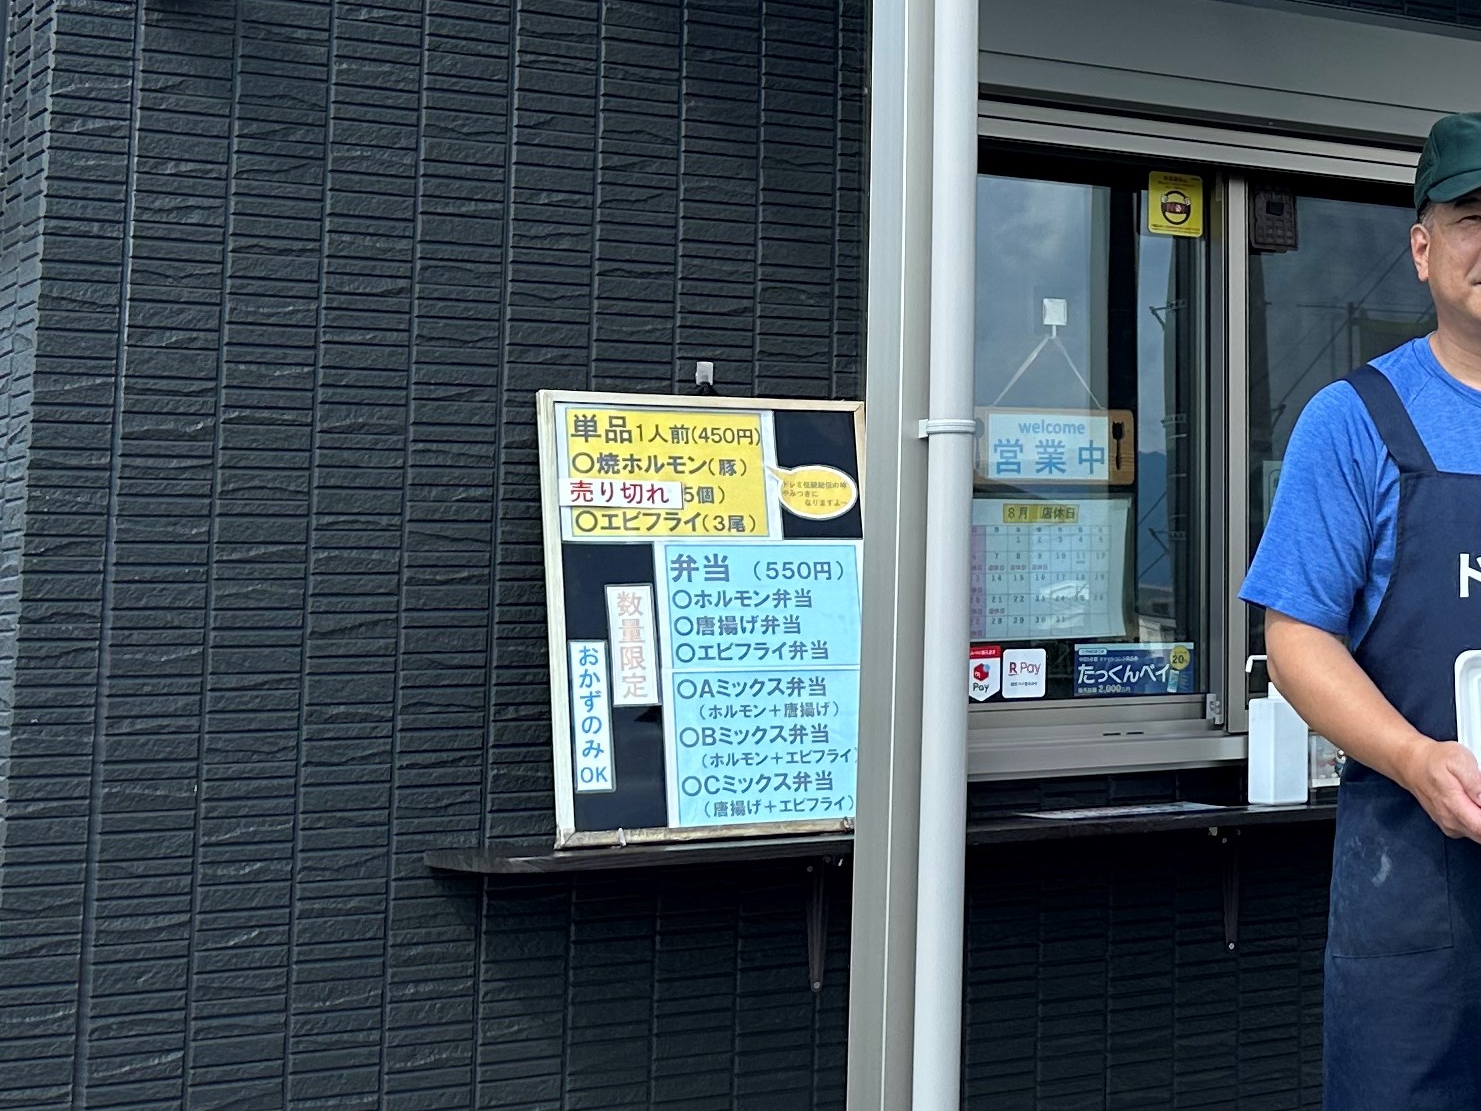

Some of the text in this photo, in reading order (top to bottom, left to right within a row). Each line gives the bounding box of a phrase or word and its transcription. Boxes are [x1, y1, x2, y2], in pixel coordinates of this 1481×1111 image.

[1018, 419, 1086, 435] welcome
[993, 437, 1106, 475] 営業中
[570, 479, 670, 505] 売り切れ
[1041, 506, 1076, 520] 店休日
[669, 553, 731, 582] 弁当
[616, 591, 650, 699] 数量限定
[1020, 661, 1041, 675] Pay
[1077, 663, 1170, 684] たっくんペイ
[973, 682, 990, 693] Pay
